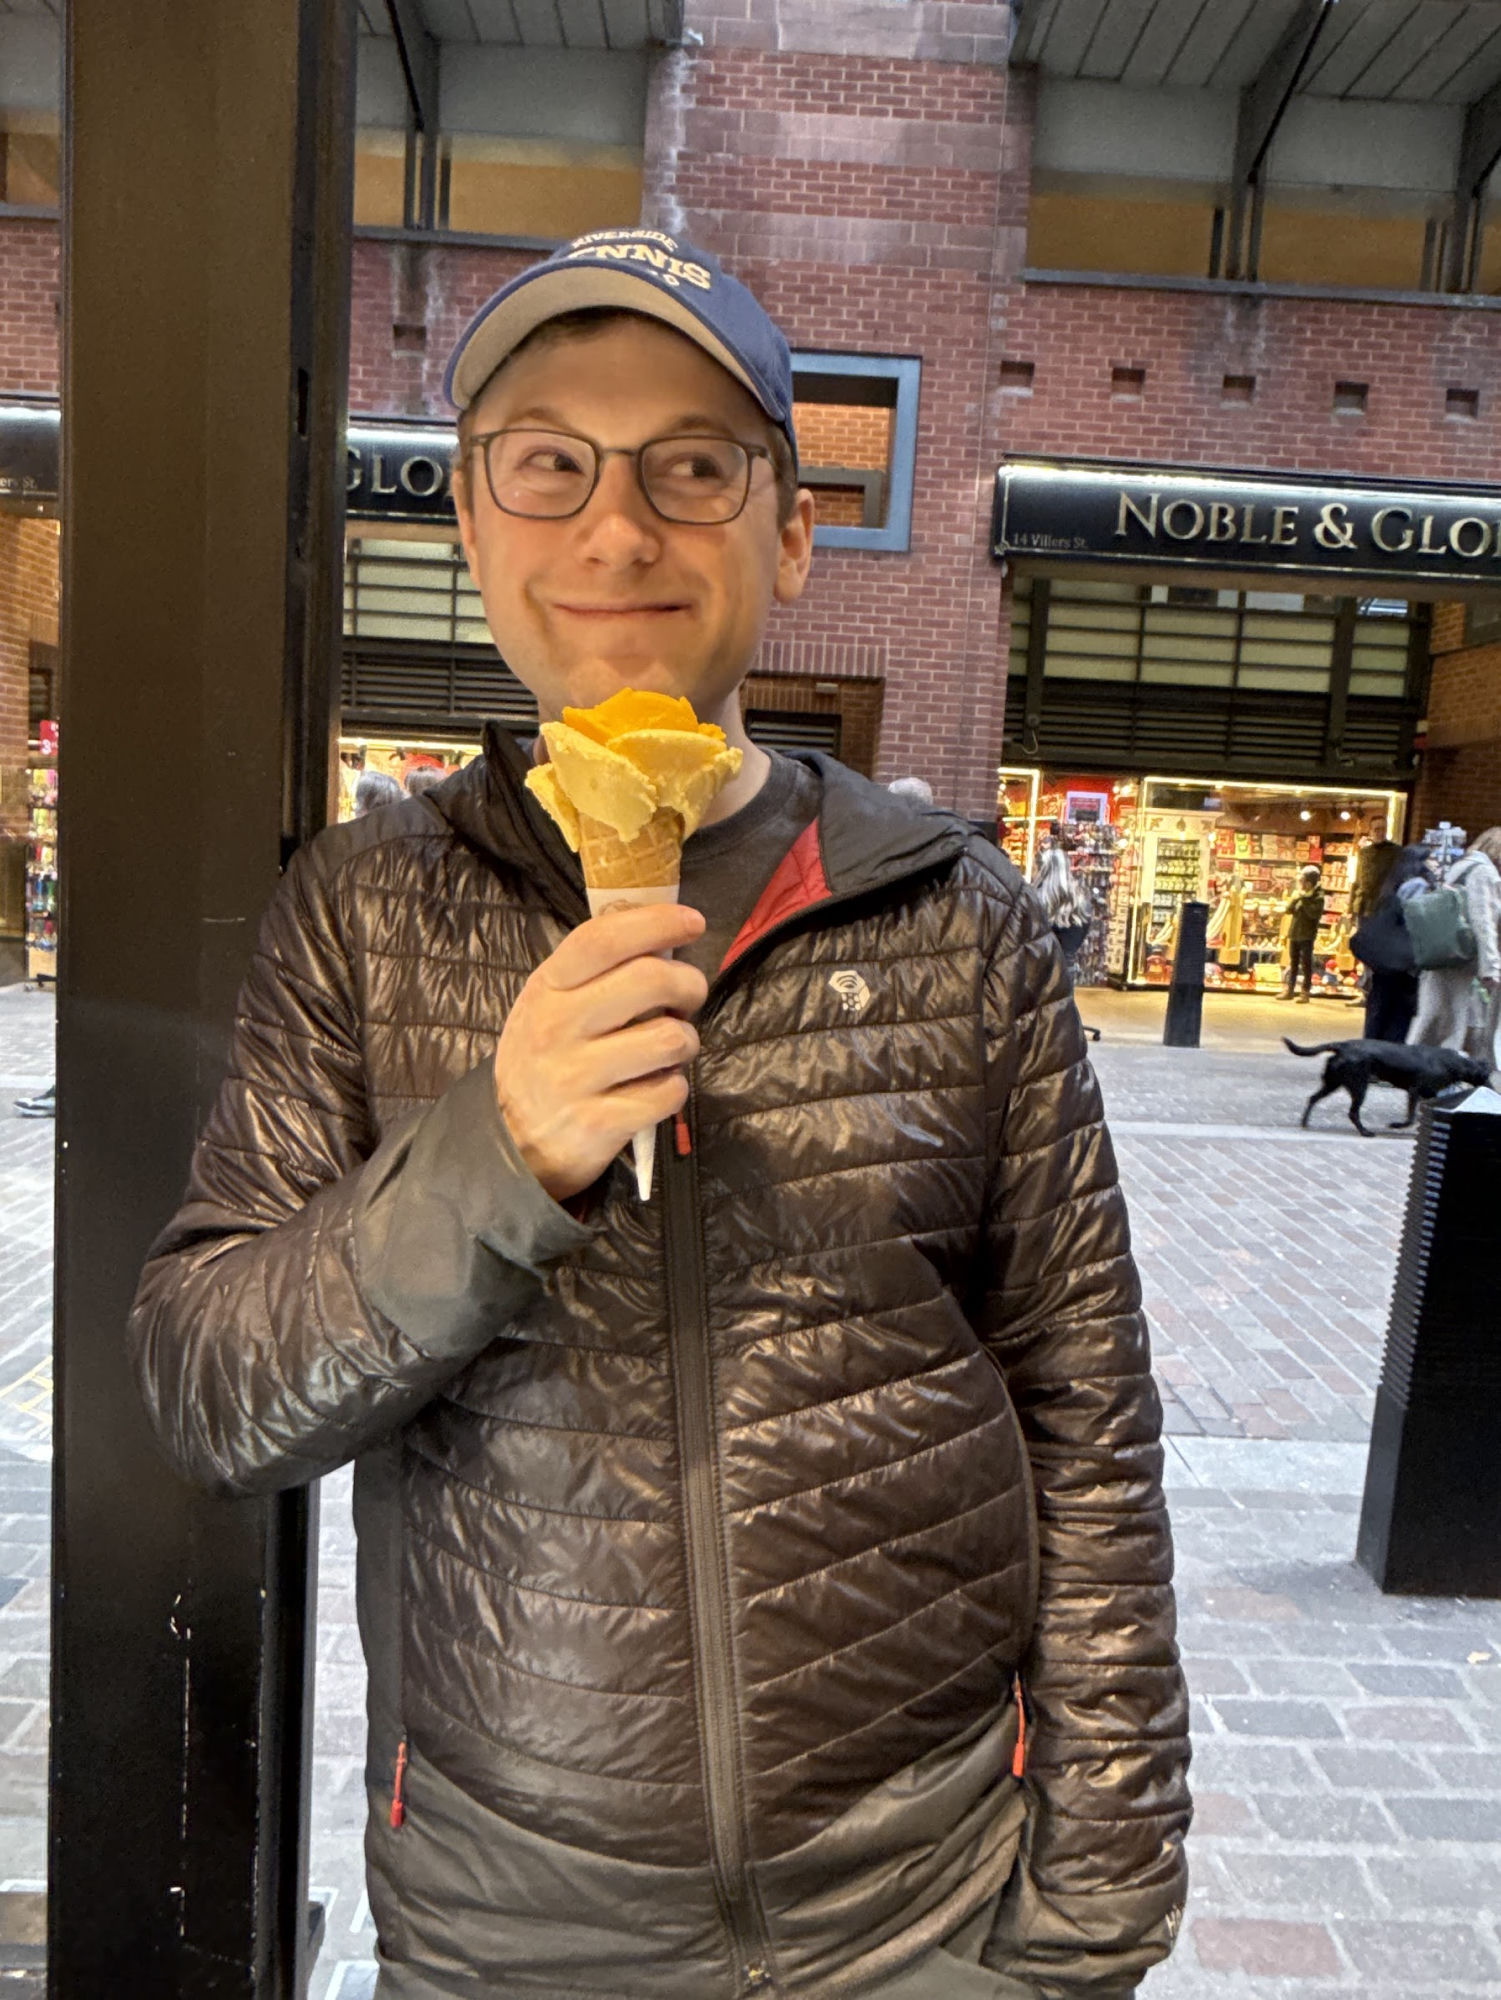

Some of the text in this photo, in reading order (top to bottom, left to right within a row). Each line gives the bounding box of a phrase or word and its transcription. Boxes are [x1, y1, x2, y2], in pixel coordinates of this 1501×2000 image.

[567, 244, 711, 290] NNIS
[1115, 491, 1299, 545] NOBLE
[1313, 503, 1358, 549] &
